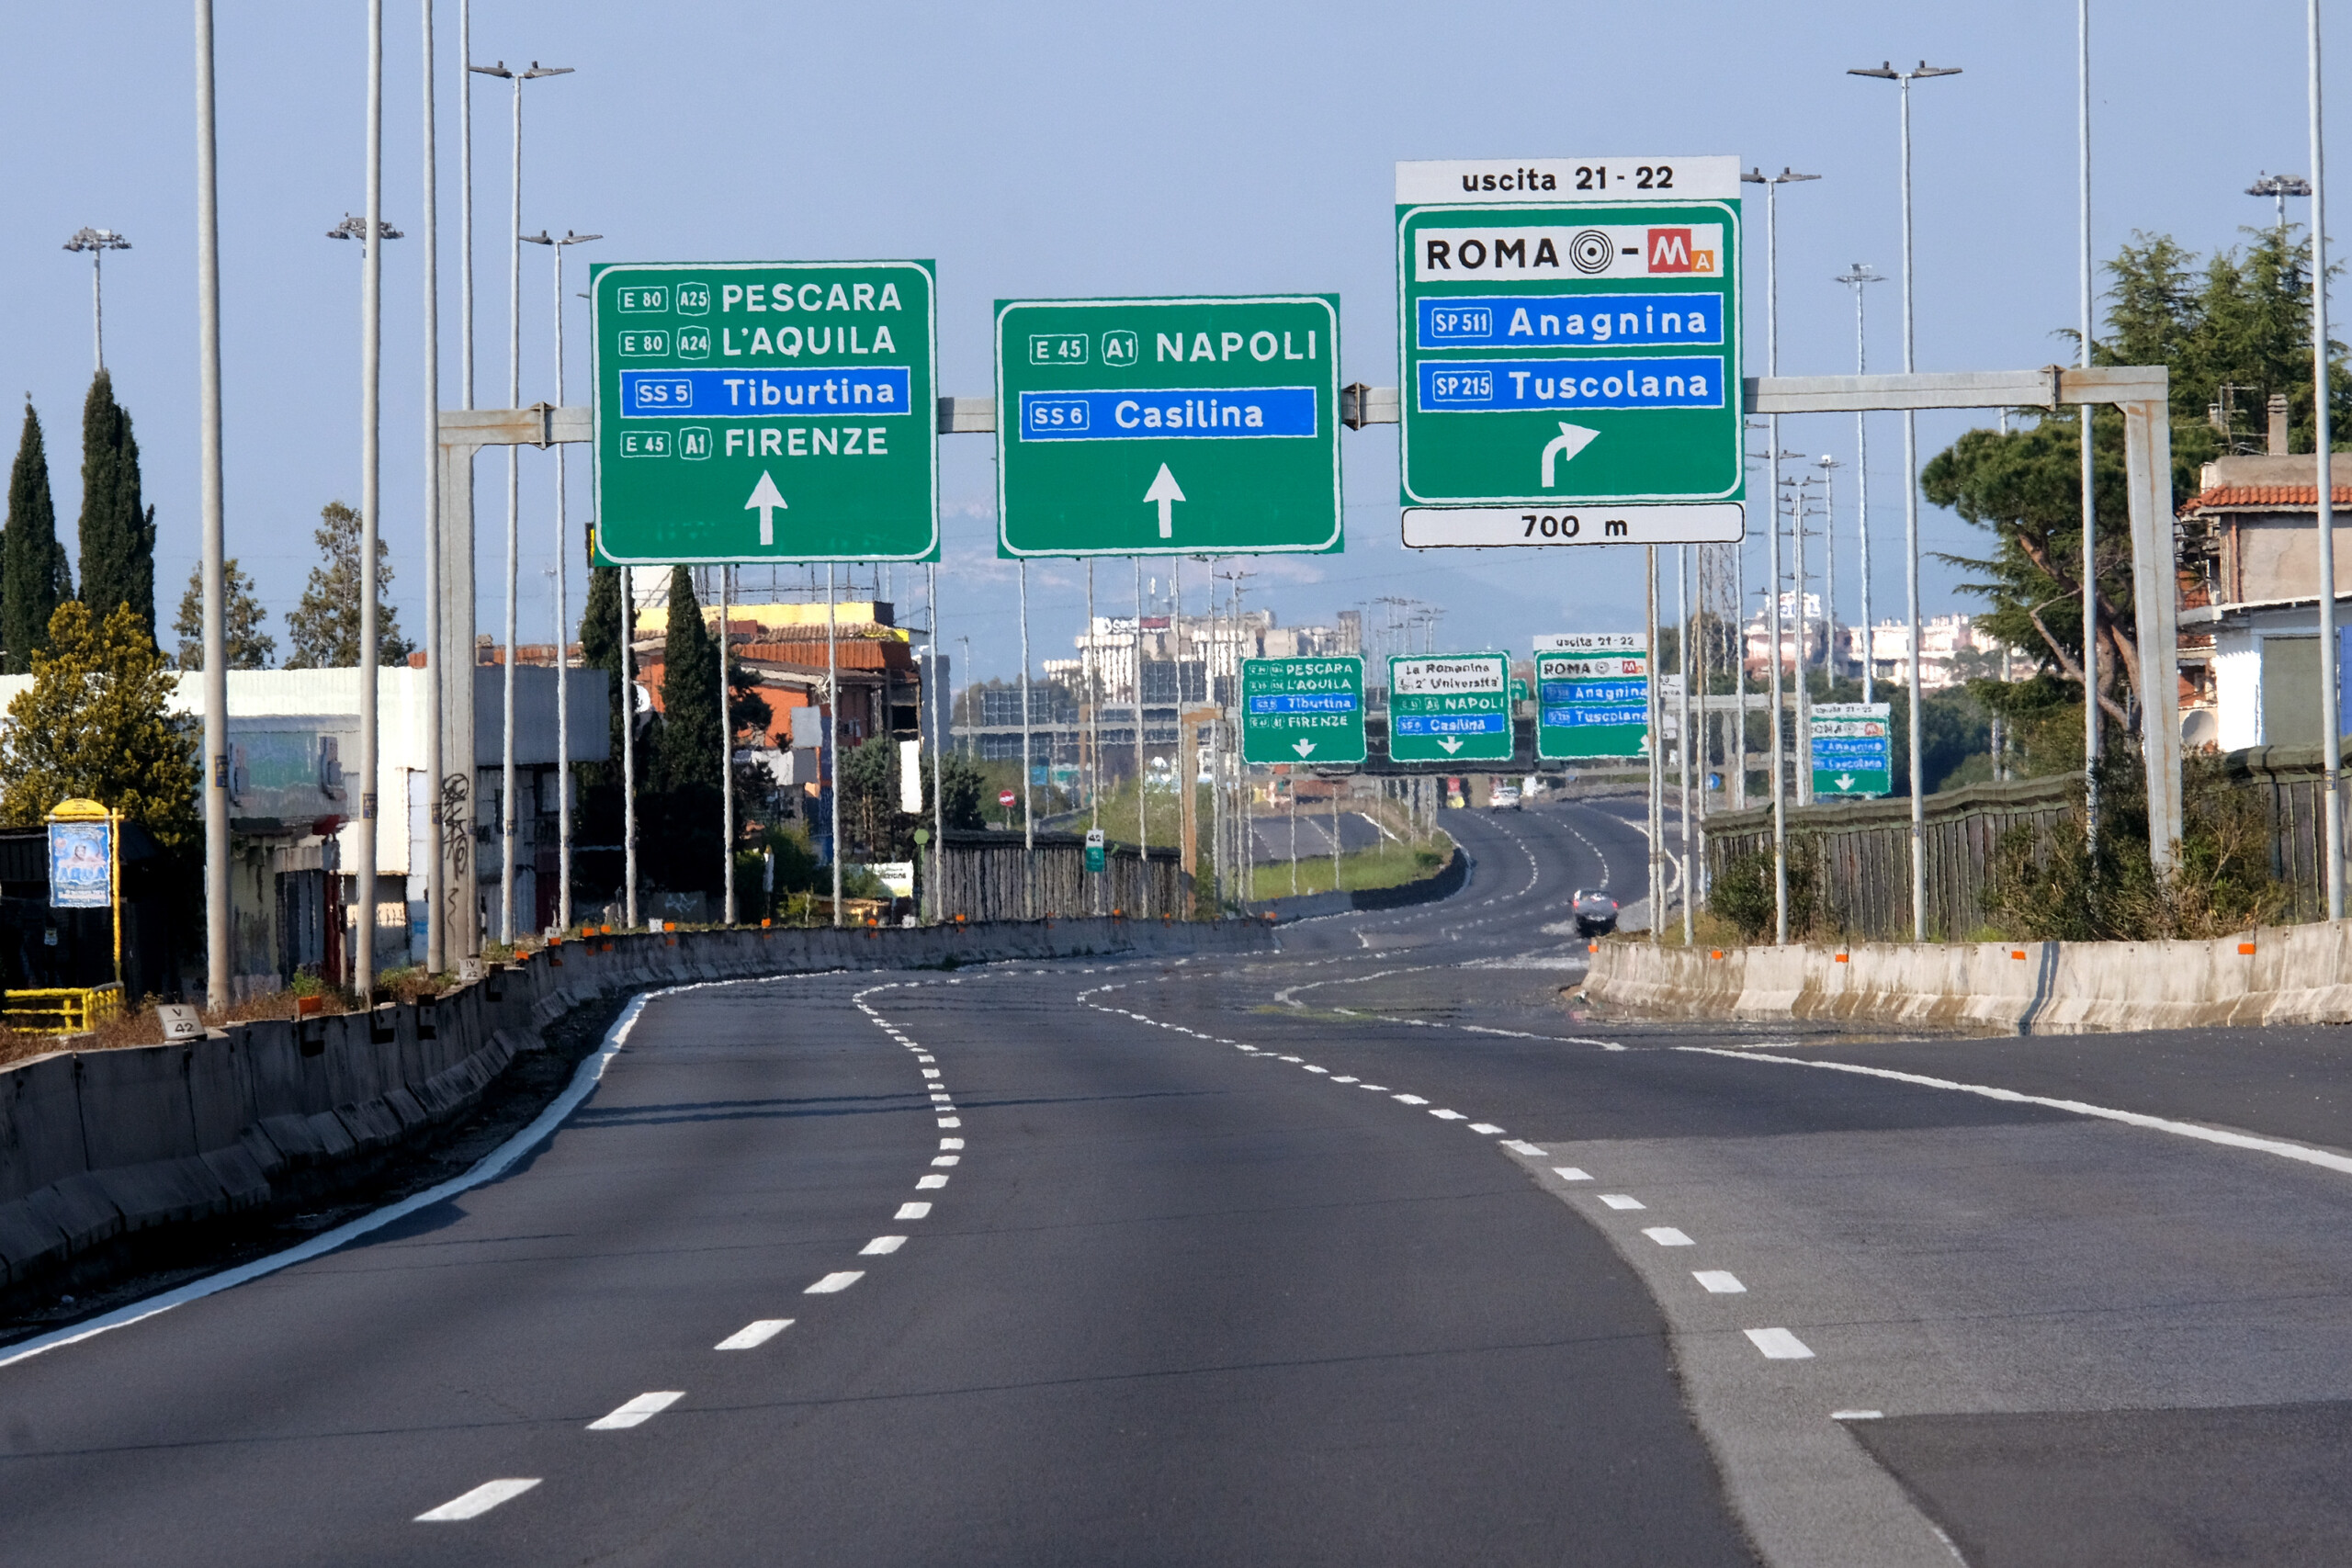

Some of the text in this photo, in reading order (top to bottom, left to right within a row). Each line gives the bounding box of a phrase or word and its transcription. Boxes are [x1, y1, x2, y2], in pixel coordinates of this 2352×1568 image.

[1462, 167, 1556, 192] uscita
[1575, 166, 1607, 190] 21
[1635, 165, 1674, 189] 22
[1427, 238, 1559, 270] ROMA
[623, 283, 902, 312] E 80 A25 PESCARA
[1436, 305, 1707, 341] SP 511 Anagnina
[625, 325, 896, 357] E 80 A24 L'AQUILA
[1036, 330, 1317, 362] E 45 A1 NAPOLI
[1437, 369, 1709, 400] SP 215 Tuscolana
[639, 378, 895, 406] SS 5 Tiburtina
[1034, 399, 1264, 428] SS 6 Casilina
[626, 427, 888, 457] E 45 A1 FIRENZE
[1521, 514, 1629, 538] 700 m
[1287, 663, 1352, 675] PESCARA
[1406, 662, 1490, 675] La Romanina
[1544, 662, 1591, 676] ROMA
[1287, 679, 1351, 690] L'AQUILA
[1576, 686, 1648, 700] Anagnina
[1287, 697, 1351, 709] Tiburtina
[1445, 696, 1504, 710] NAPOLI
[1288, 716, 1348, 728] FIRENZE
[1575, 710, 1648, 723] Tuscolana
[1430, 719, 1486, 731] Casilina
[1088, 834, 1101, 842] 42
[172, 1008, 182, 1017] V
[175, 1022, 195, 1032] 42
